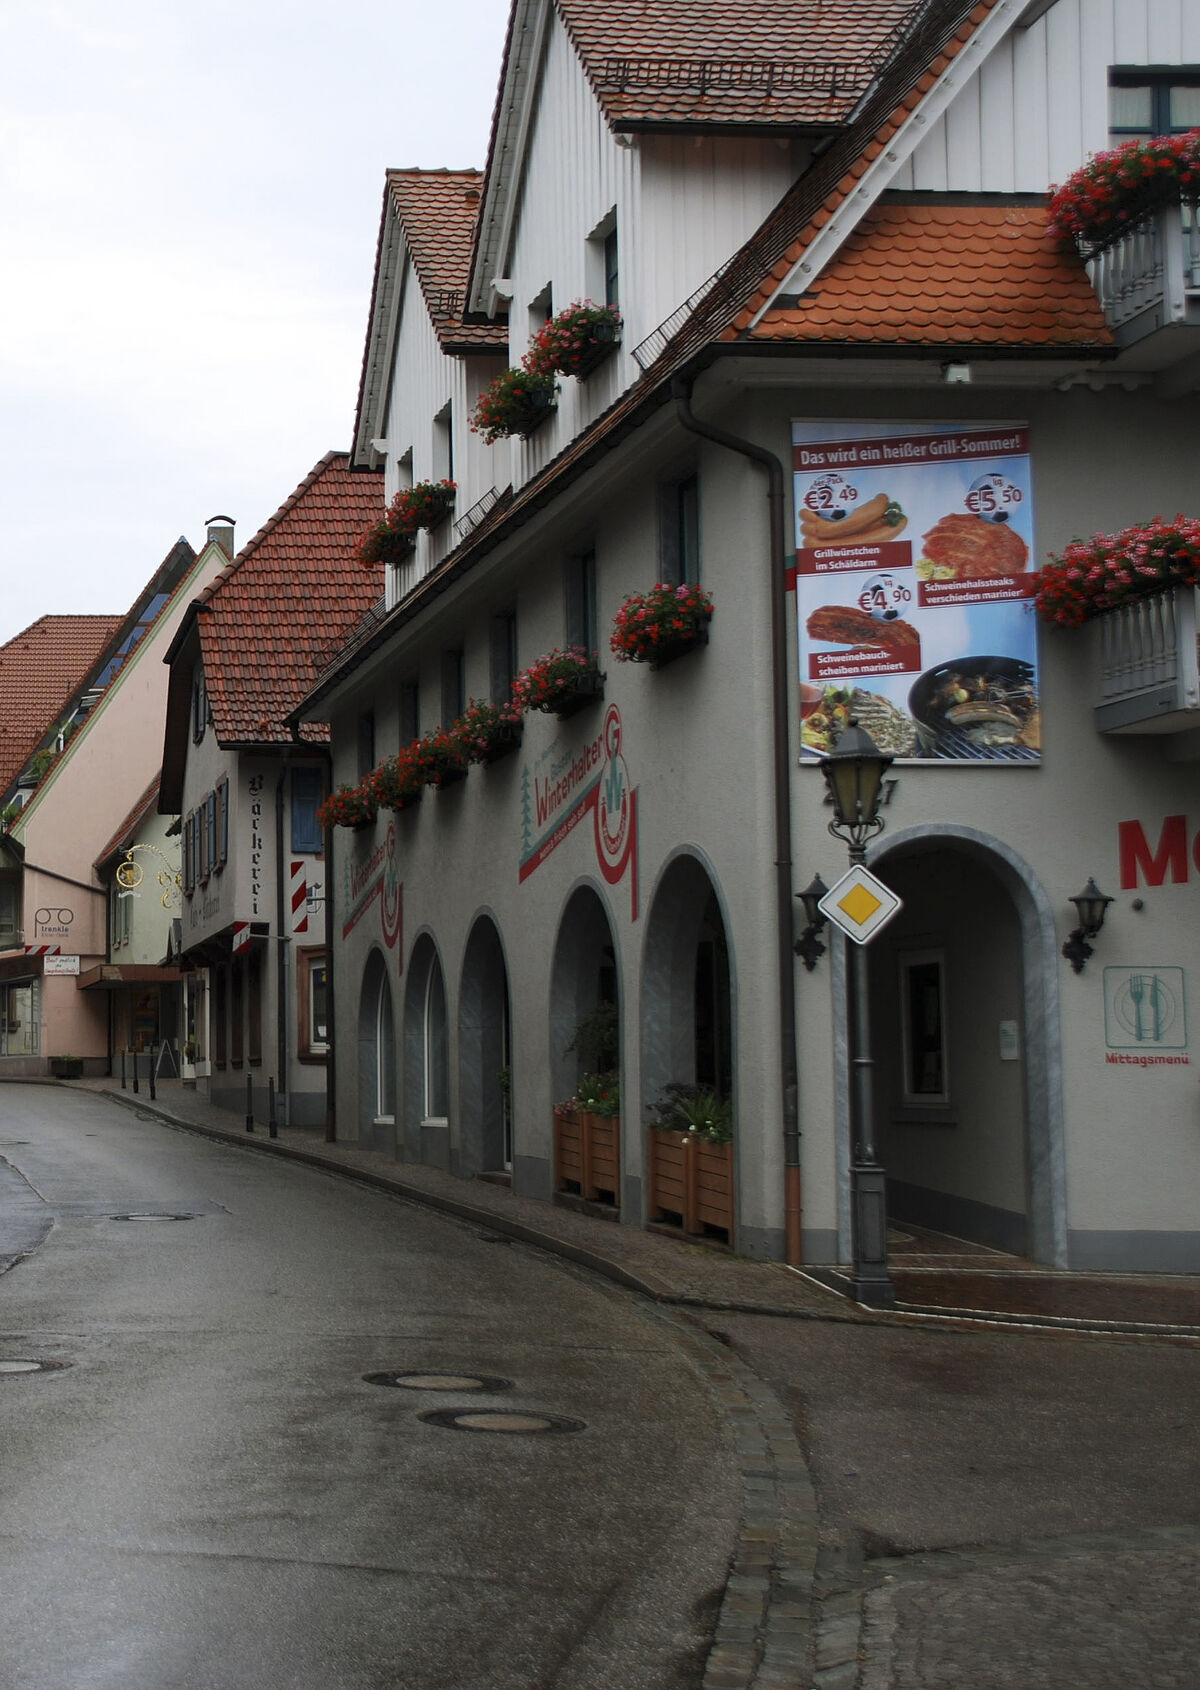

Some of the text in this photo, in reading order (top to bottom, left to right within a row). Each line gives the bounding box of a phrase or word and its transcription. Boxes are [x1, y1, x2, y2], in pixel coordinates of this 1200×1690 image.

[800, 434, 1021, 465] Das wird ein heißer Grill-Sommer!
[814, 545, 881, 559] Grillwürstchen
[815, 557, 877, 571] im Schäldarm
[924, 577, 1014, 592] Schweinehalssteaks
[926, 592, 980, 604] verschieden
[817, 650, 891, 664] Schweinebauch-
[818, 661, 904, 676] scheiben mariniert
[535, 734, 603, 827] Winterhalter
[248, 774, 264, 914] Bäckerei
[1118, 814, 1200, 890] M
[1104, 1052, 1190, 1068] Mittagsmenü
